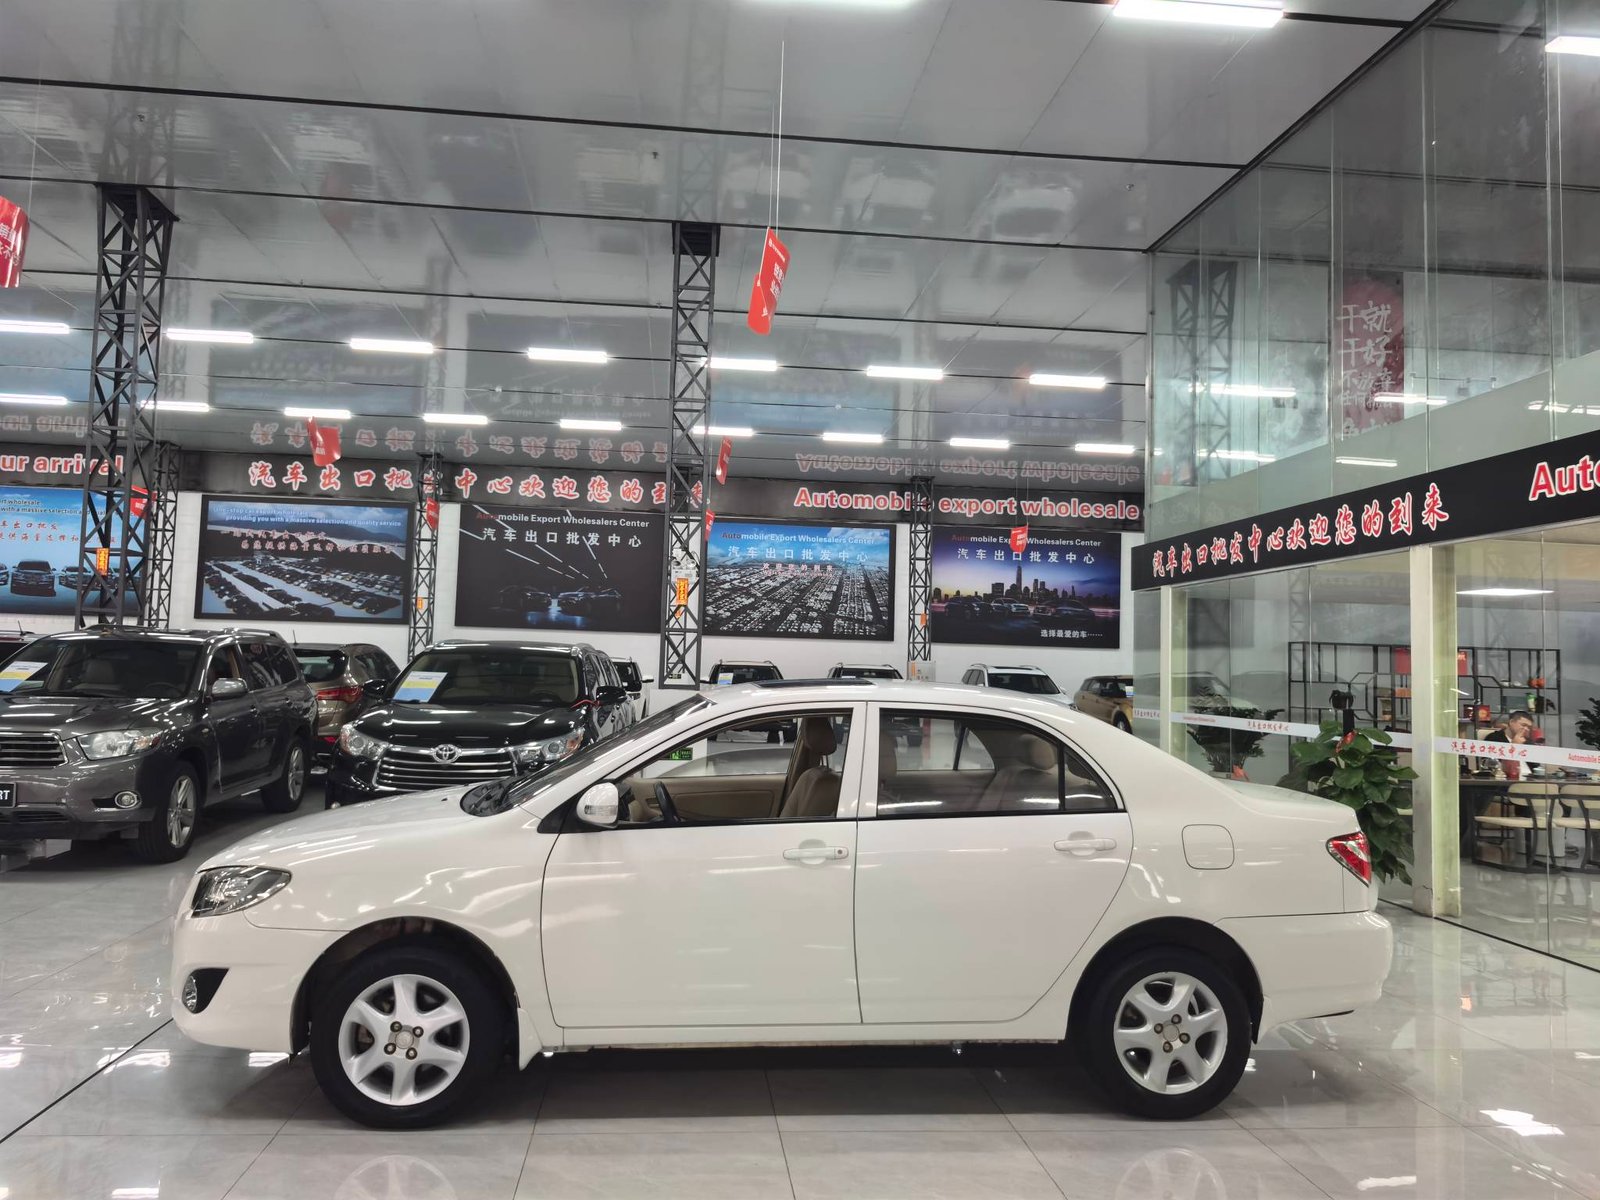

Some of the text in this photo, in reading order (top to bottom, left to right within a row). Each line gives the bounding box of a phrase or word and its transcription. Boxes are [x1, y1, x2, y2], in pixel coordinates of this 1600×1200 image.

[938, 497, 1017, 517] export
[1020, 497, 1139, 520] wholesale
[530, 514, 560, 524] Export
[562, 515, 618, 526] Wholesalers
[619, 518, 649, 528] Center
[482, 527, 642, 548] 汽车出口批发中心
[1152, 483, 1449, 578] 汽车出口批发中心欢迎您的到来
[770, 533, 797, 543] Export
[797, 534, 847, 544] Wholesalers
[848, 536, 875, 545] Center
[951, 534, 998, 544] Automobile
[1026, 537, 1074, 546] Wholesalers
[1075, 539, 1102, 547] Center
[727, 545, 868, 562] 汽车出口批发中心
[957, 548, 1095, 564] 汽车出口批发中心
[1450, 741, 1528, 757] 汽车出口批发中心
